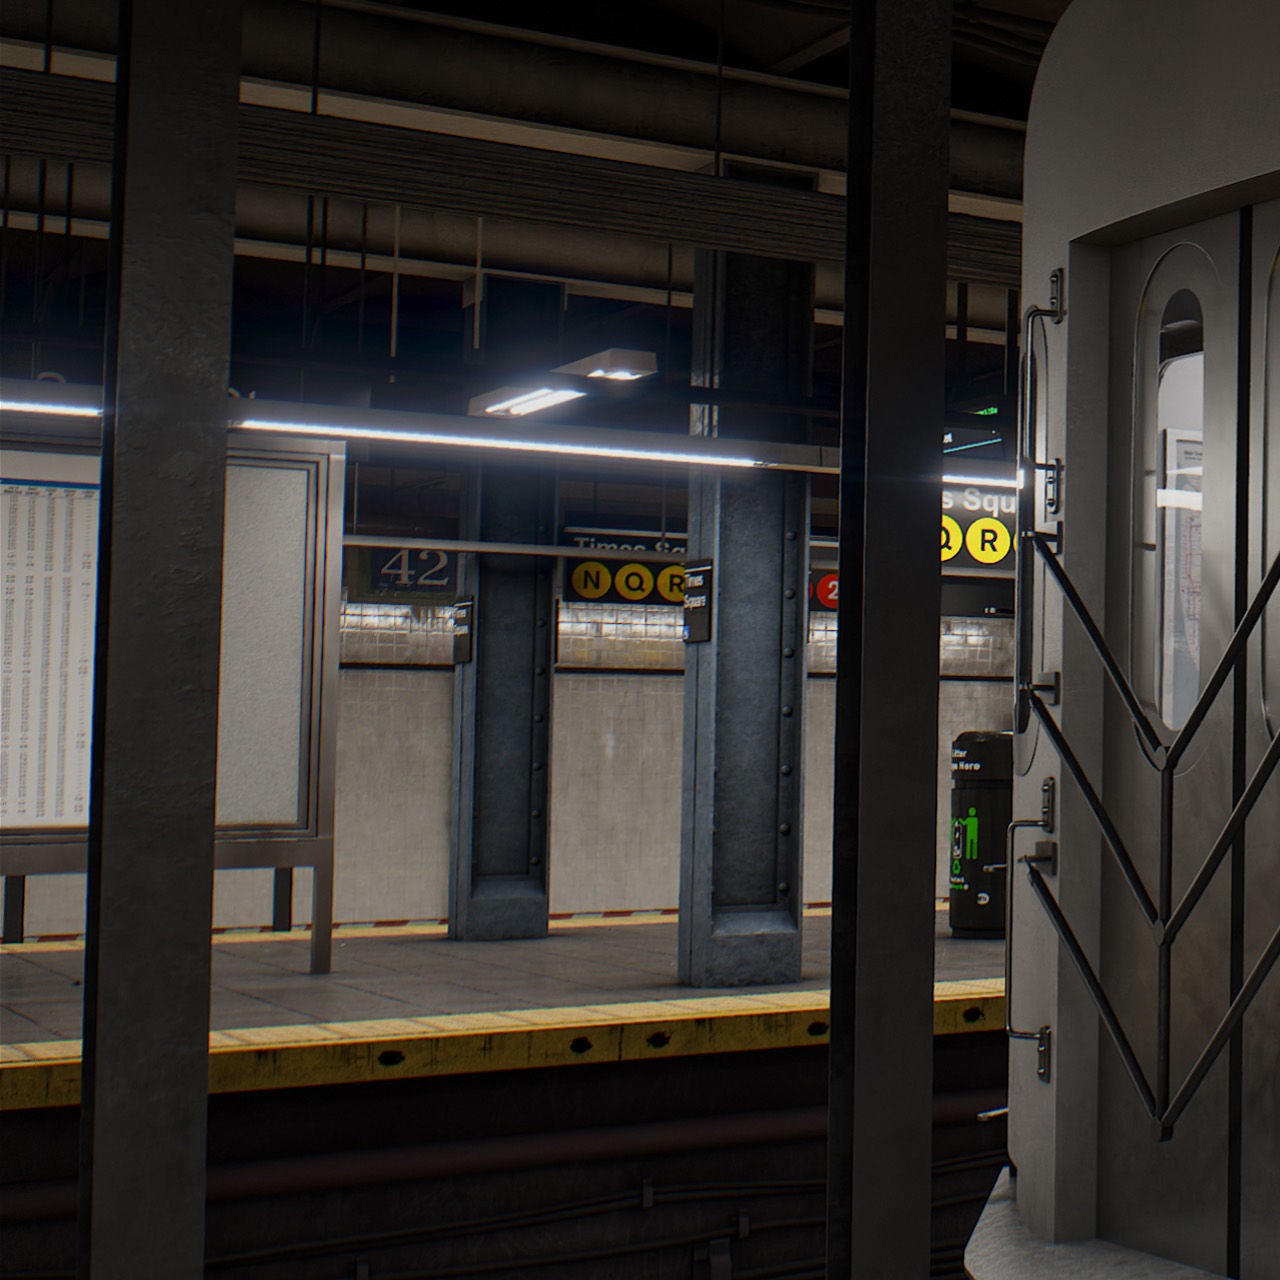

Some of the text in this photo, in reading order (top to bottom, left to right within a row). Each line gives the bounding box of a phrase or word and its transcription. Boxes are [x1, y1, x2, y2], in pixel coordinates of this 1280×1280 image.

[980, 529, 998, 552] R
[381, 549, 449, 586] 42
[583, 571, 684, 593] N Q R
[827, 580, 839, 600] 2
